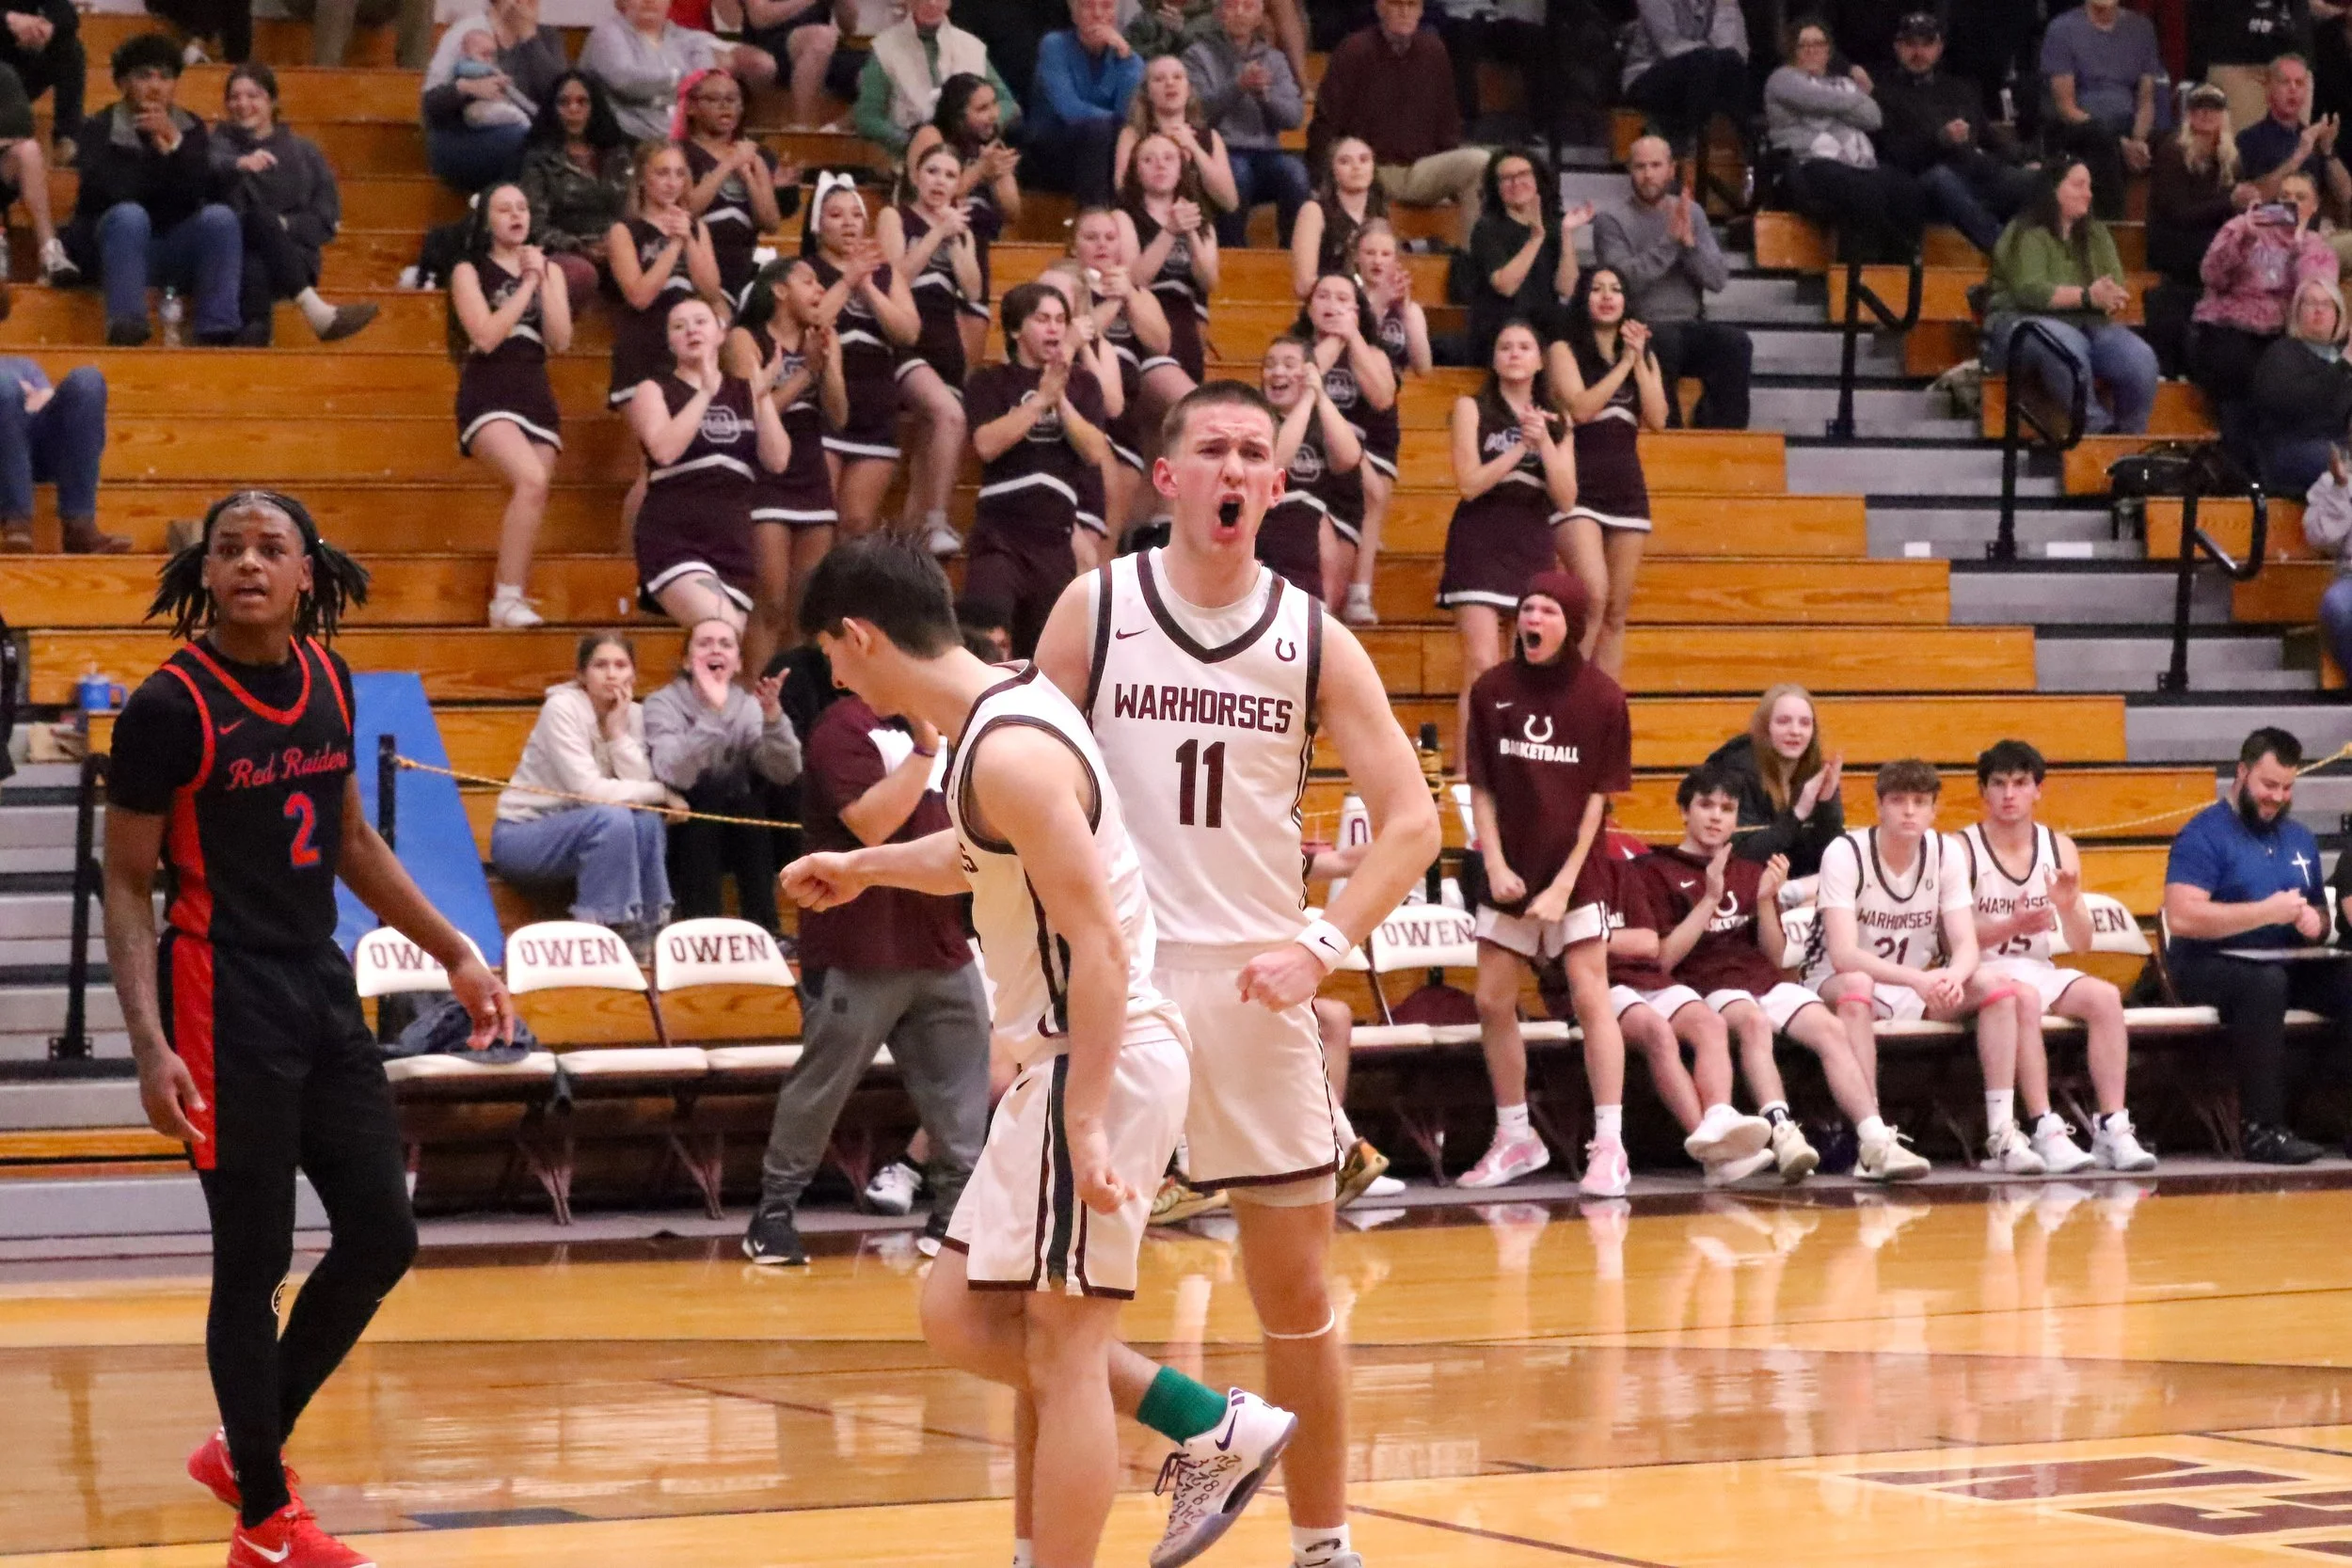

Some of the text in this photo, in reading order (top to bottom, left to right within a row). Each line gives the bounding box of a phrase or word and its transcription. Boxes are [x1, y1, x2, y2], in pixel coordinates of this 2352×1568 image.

[1115, 684, 1293, 734] WARHORSES
[226, 753, 275, 790] Red
[1176, 738, 1225, 828] 11
[283, 792, 321, 867] 2
[1382, 919, 1475, 946] OWEN
[1857, 908, 1932, 929] WARHORSES
[519, 938, 620, 966] OWEN
[670, 934, 771, 962] OWEN
